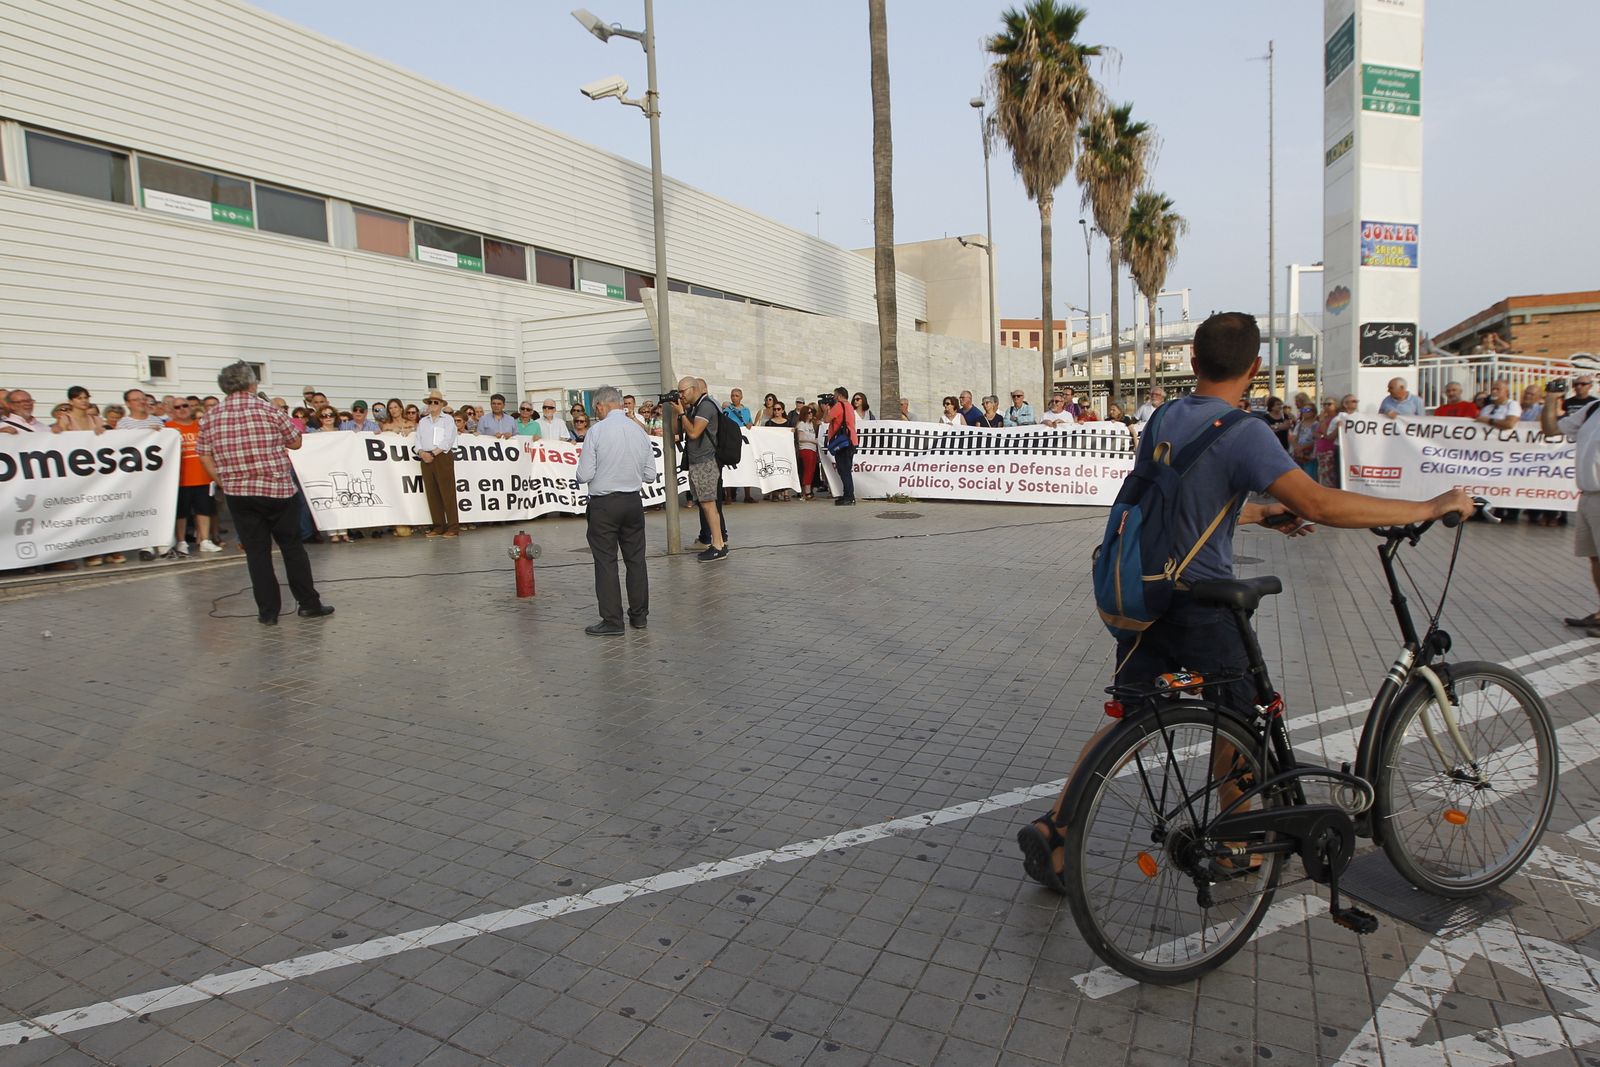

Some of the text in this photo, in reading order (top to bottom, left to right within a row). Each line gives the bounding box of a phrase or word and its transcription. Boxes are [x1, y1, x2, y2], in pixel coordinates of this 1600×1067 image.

[1363, 224, 1417, 243] JOKER
[1345, 420, 1377, 435] POR
[1383, 422, 1400, 436] EL
[1405, 423, 1477, 440] EMPLEO
[1483, 427, 1495, 441] Y
[1498, 429, 1519, 443] LA
[365, 439, 520, 462] Busando
[1422, 446, 1504, 463] EXIGIMOS
[0, 445, 163, 482] omesas
[903, 461, 984, 473] Almeriense
[988, 463, 1005, 473] en
[1010, 462, 1071, 476] Defensa
[1075, 464, 1098, 478] del
[1420, 462, 1577, 479] EXIGIMOS INFRAE
[402, 475, 470, 493] Ma
[478, 478, 504, 492] en
[899, 474, 1098, 495] Público, Social y Sostenible
[481, 494, 500, 510] la
[507, 490, 590, 510] Provincia
[1515, 488, 1582, 500] FERROV
[41, 518, 73, 529] Mesa
